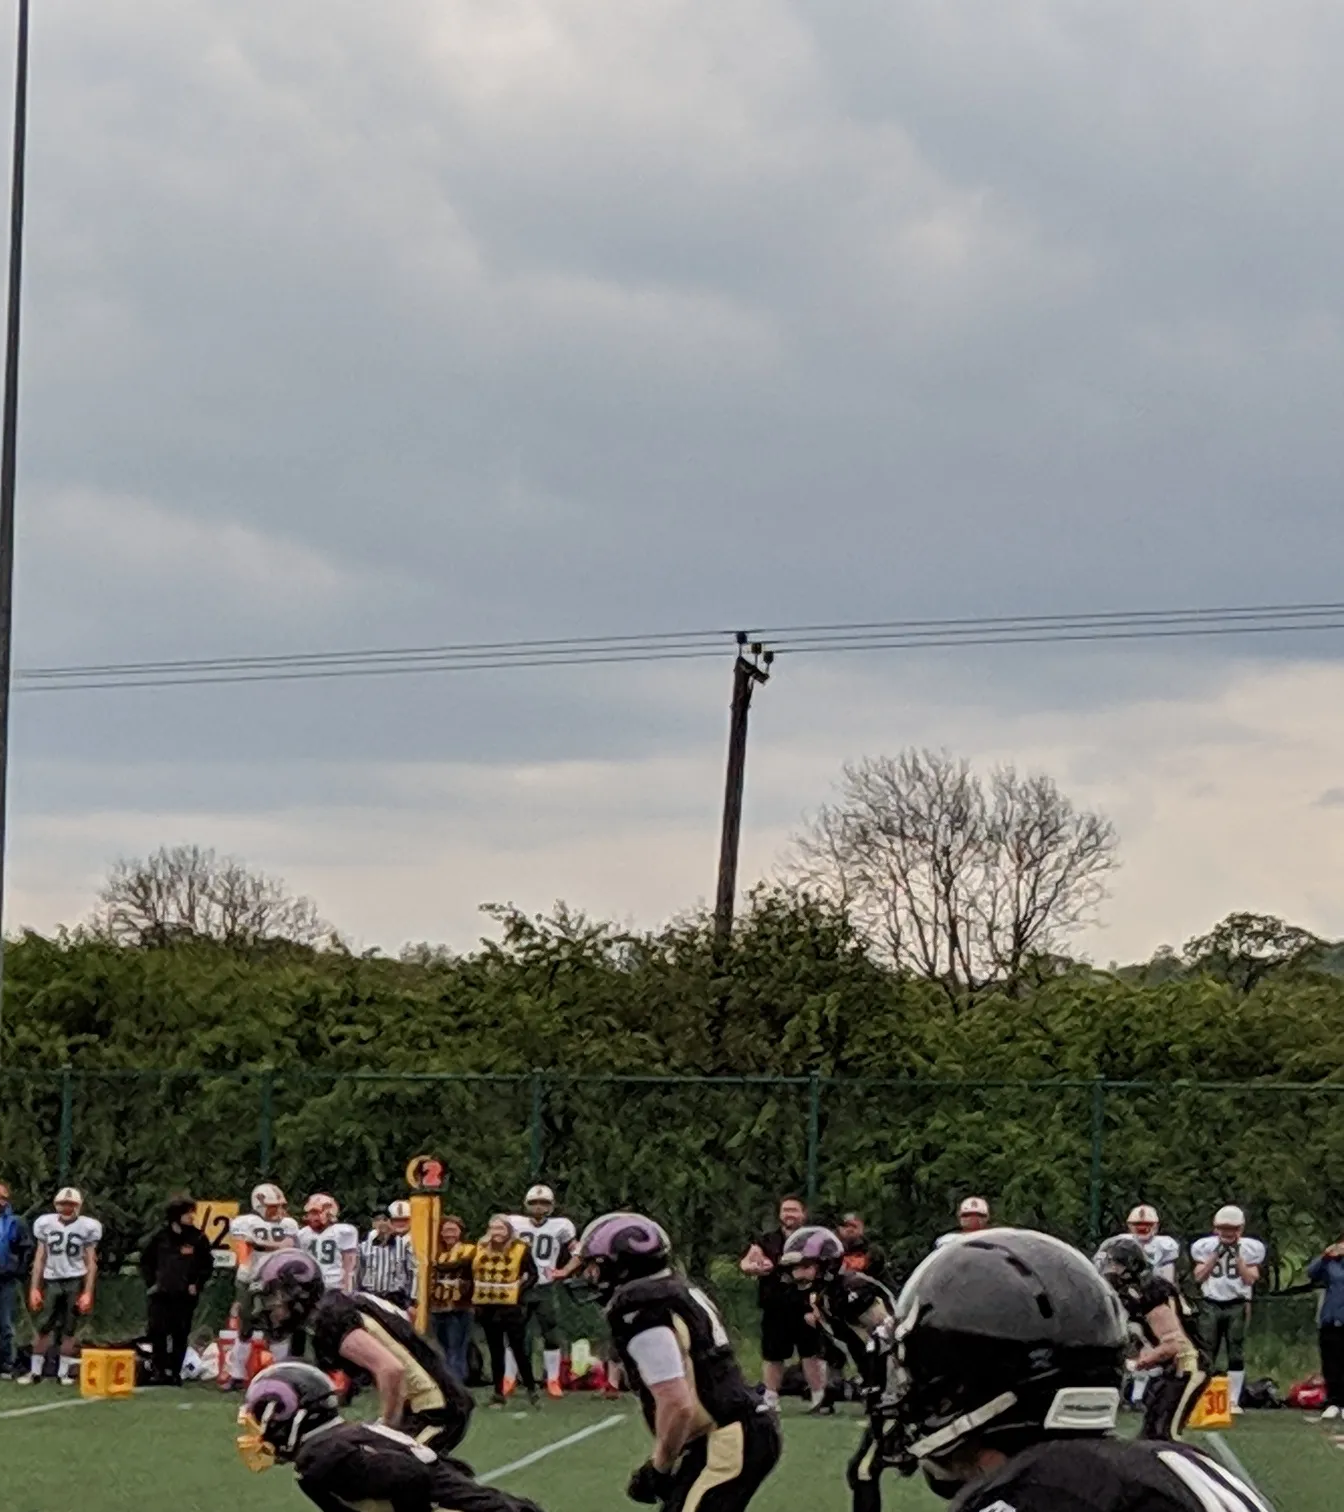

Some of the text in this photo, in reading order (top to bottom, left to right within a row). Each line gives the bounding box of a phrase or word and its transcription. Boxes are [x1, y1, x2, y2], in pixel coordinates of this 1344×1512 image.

[422, 1160, 443, 1187] 2
[50, 1231, 83, 1257] 26
[1205, 1390, 1228, 1415] 30
